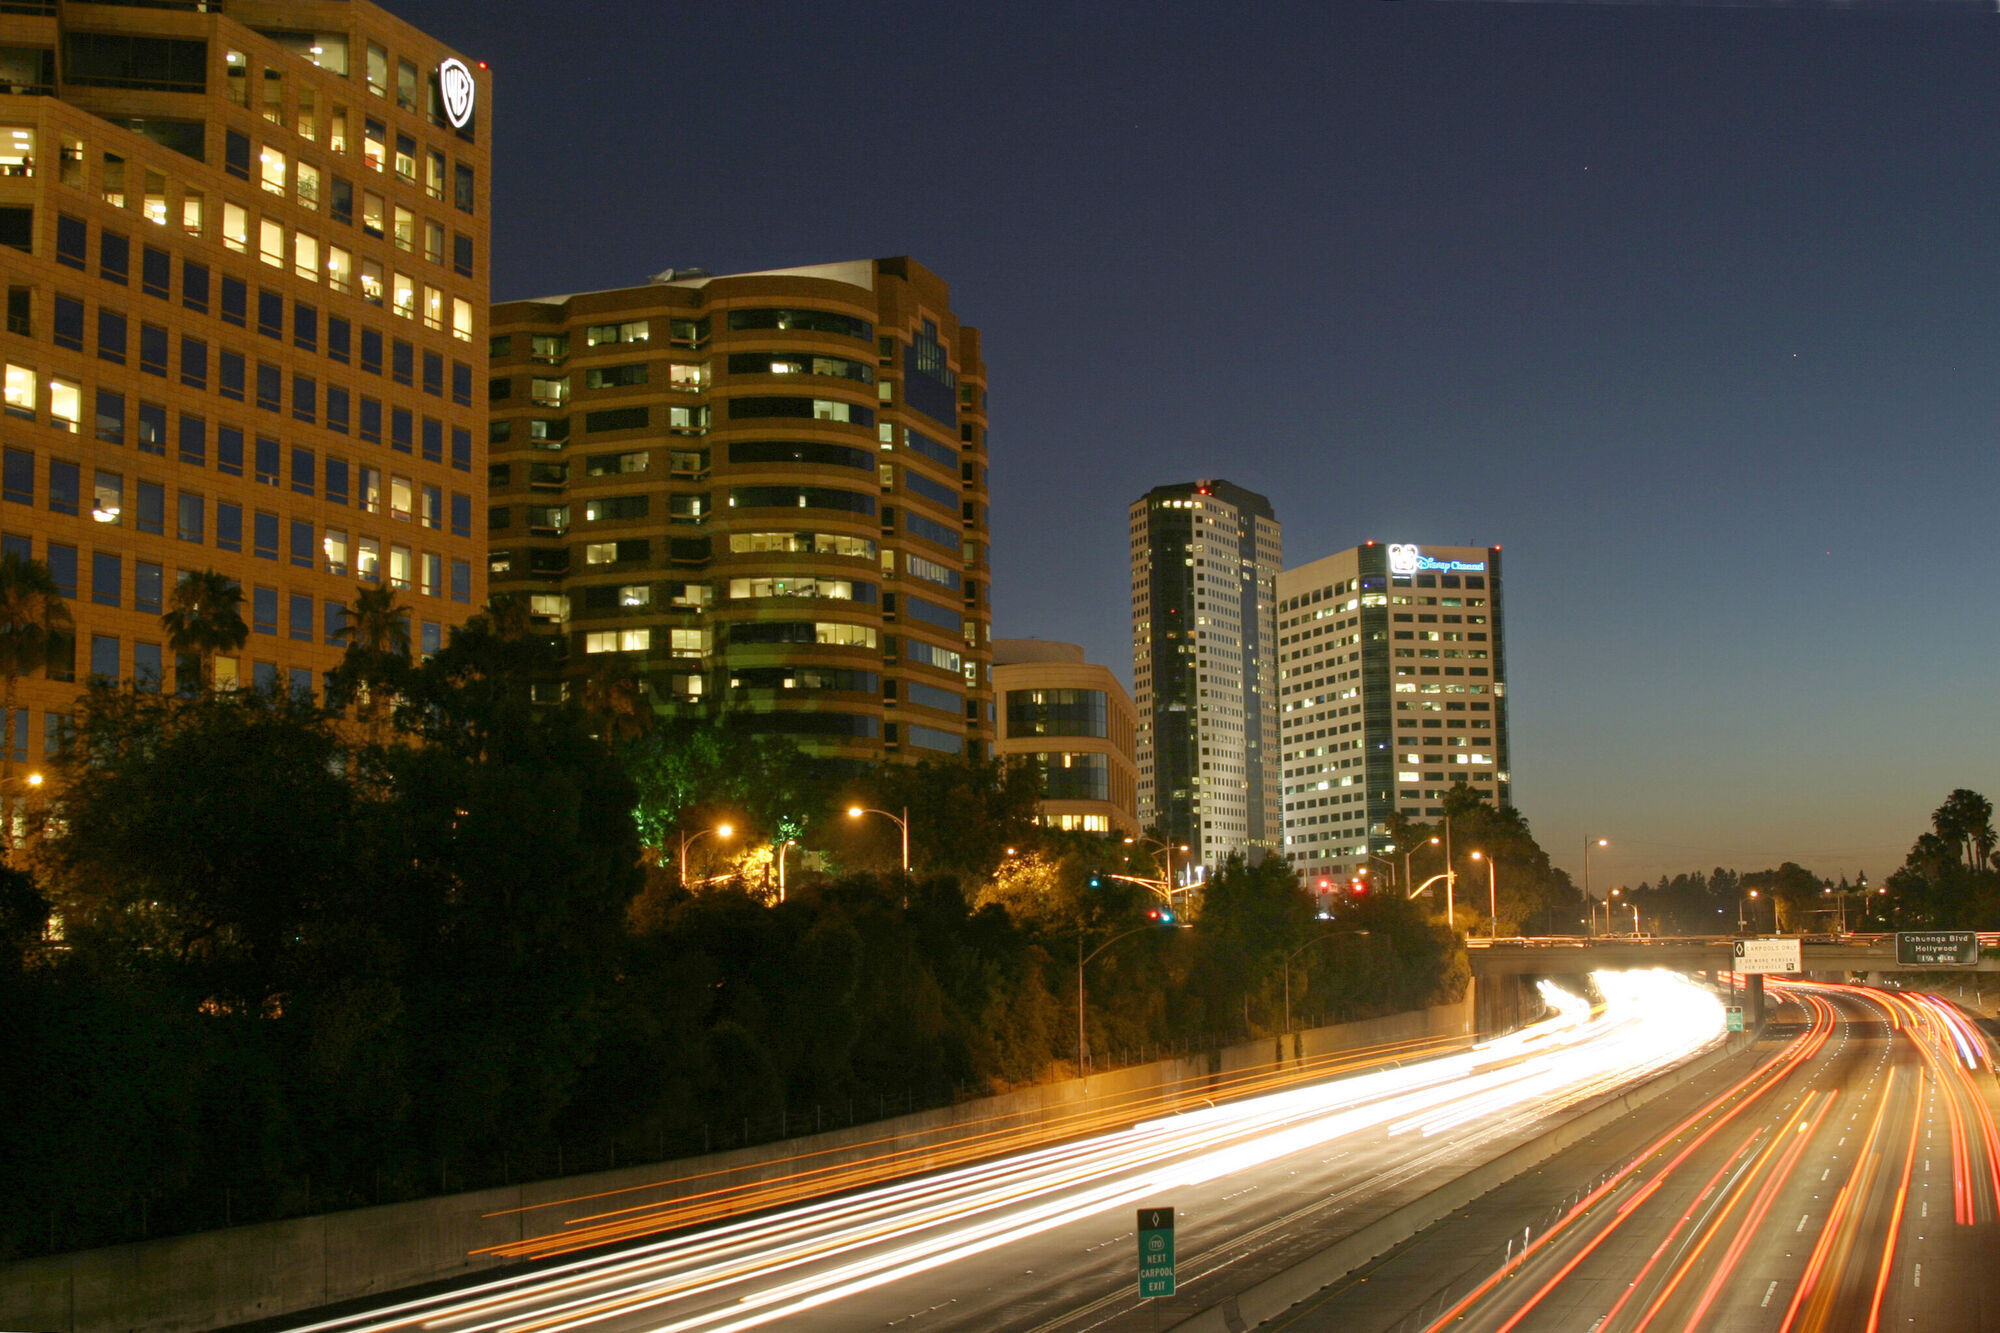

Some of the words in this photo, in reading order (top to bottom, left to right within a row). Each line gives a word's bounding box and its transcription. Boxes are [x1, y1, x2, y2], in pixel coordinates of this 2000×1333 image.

[445, 67, 470, 117] WB
[1416, 555, 1450, 573] Disney
[1451, 560, 1485, 571] Channel
[1904, 935, 1946, 943] Cahuenga
[1915, 945, 1958, 953] Hollywood
[1151, 1240, 1162, 1249] 170
[1147, 1254, 1167, 1264] NEXT
[1140, 1267, 1173, 1279] CARPOOL
[1148, 1281, 1166, 1291] EXIT
